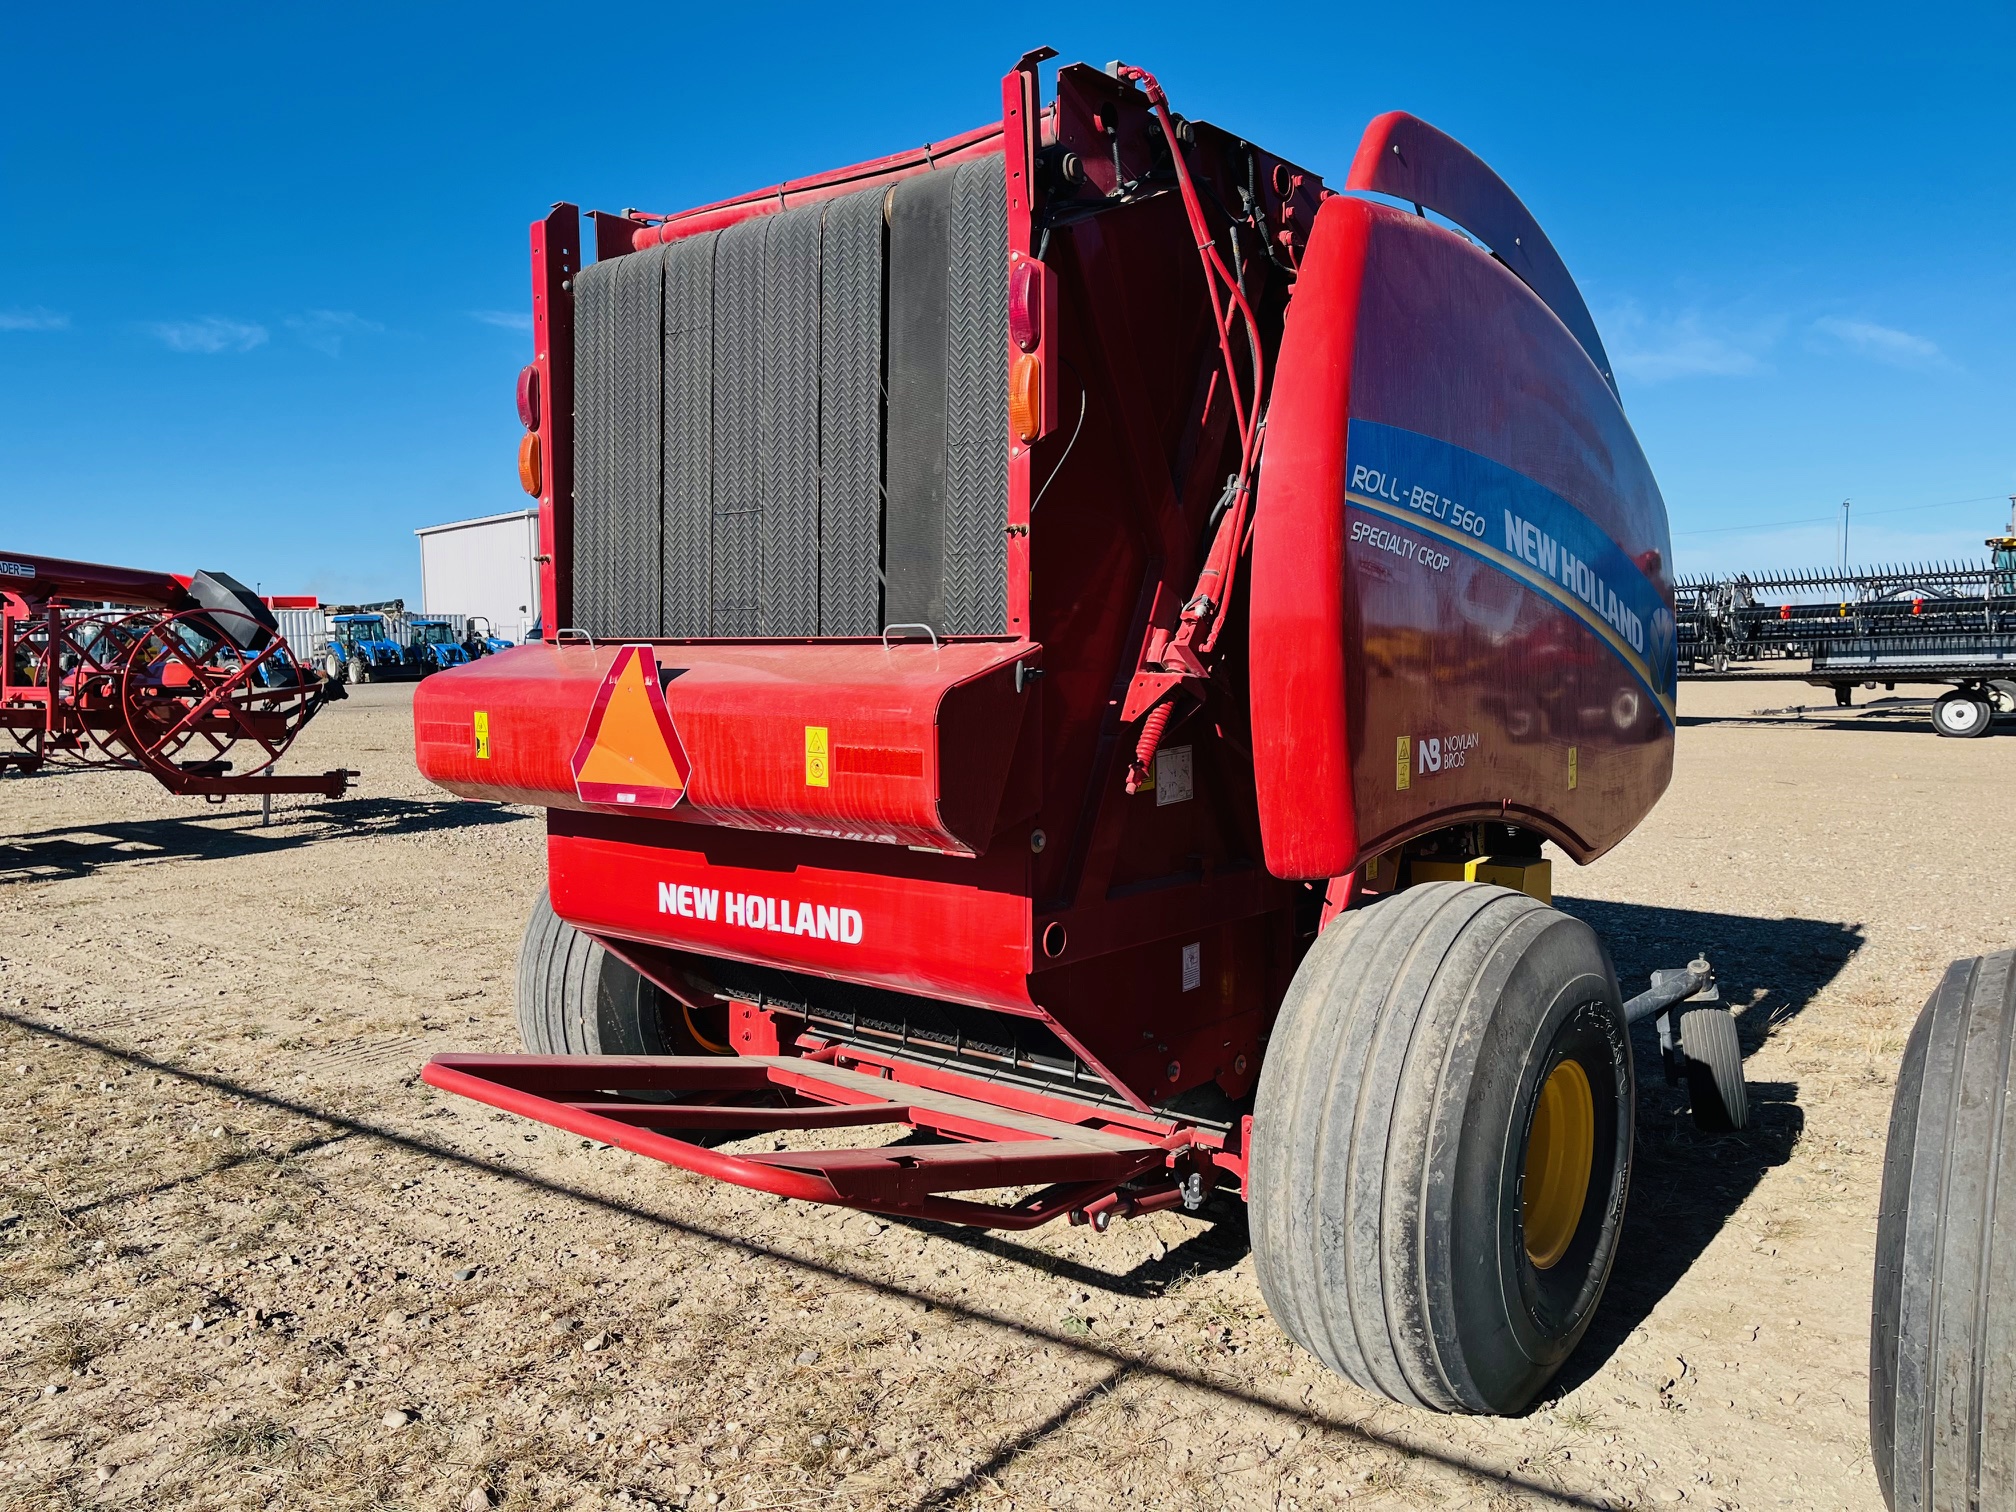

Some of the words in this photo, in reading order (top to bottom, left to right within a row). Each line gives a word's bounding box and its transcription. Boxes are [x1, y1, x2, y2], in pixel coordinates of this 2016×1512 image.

[1451, 503, 1486, 537] 560
[1350, 521, 1418, 560] SPECIALTY
[1418, 546, 1450, 572] CROP
[1504, 508, 1557, 578] NEW
[1561, 545, 1644, 654] HOLLAND
[1443, 732, 1479, 751] NOVLAN
[1443, 751, 1465, 770] BROS
[658, 881, 719, 922] NEW
[725, 891, 863, 945] HOLLAND
